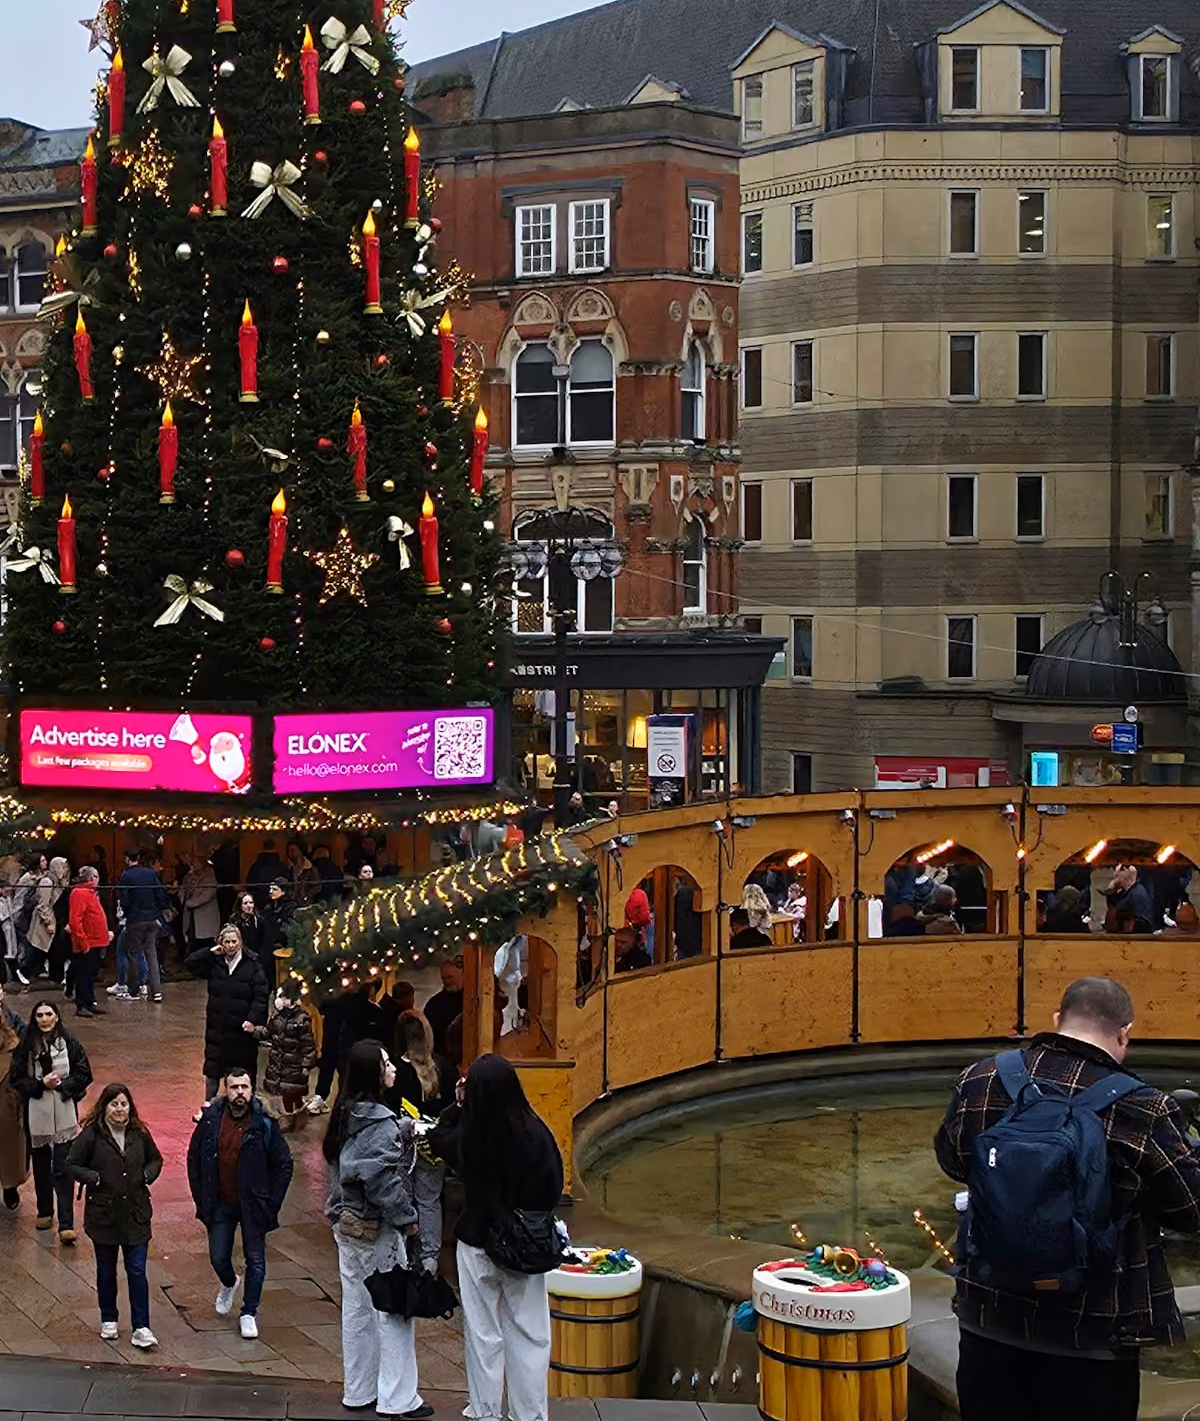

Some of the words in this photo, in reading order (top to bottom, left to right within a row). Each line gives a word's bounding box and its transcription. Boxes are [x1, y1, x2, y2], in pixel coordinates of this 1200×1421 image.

[30, 724, 119, 747] Advertise
[122, 726, 166, 749] here
[287, 732, 367, 755] ELONEX
[37, 755, 54, 766] Last
[54, 755, 71, 767] few
[71, 756, 111, 770] packages
[288, 761, 399, 778] hello@elonex.com
[759, 1290, 857, 1324] Christmas
